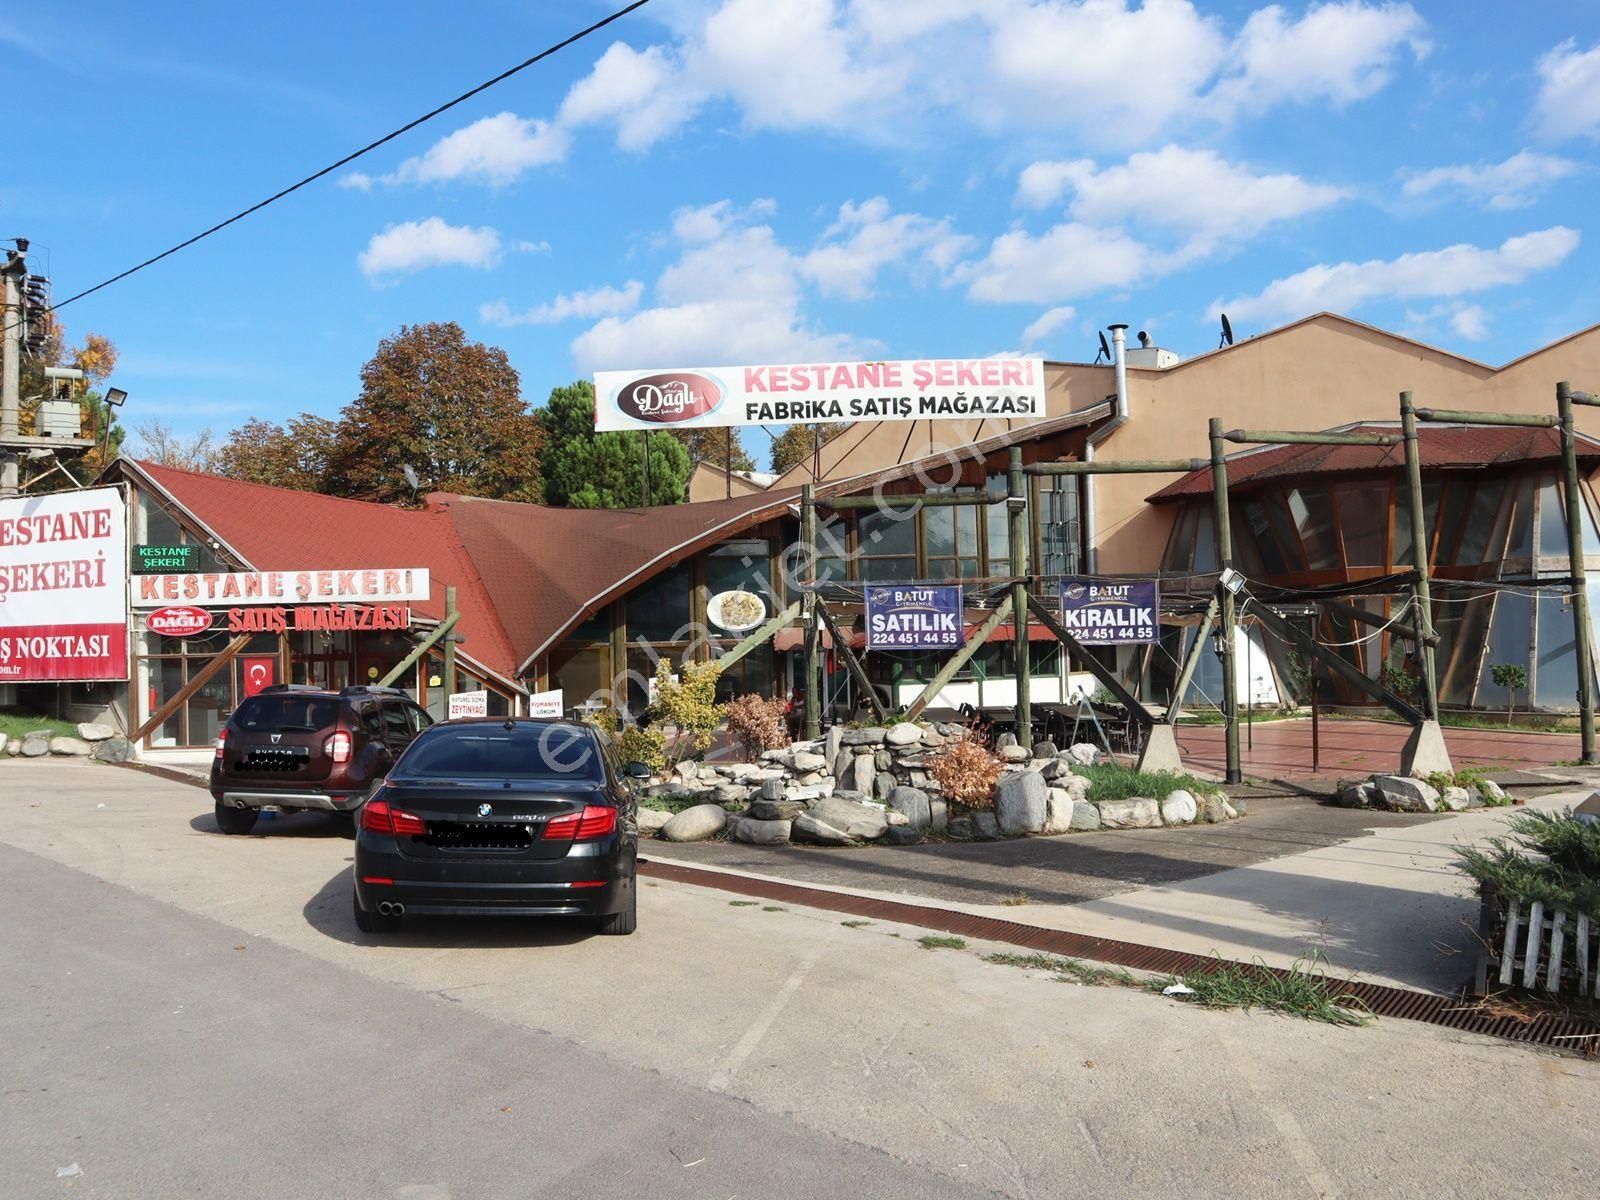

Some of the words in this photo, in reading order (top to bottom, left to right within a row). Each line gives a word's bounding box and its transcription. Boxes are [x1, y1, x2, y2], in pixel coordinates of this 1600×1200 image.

[744, 363, 902, 392] KESTANE
[850, 397, 912, 418] SATIŞ
[919, 391, 1036, 414] MAĞAZASI
[139, 547, 191, 557] KESTANE
[143, 557, 186, 568] ŞEKERİ
[141, 572, 284, 599] KESTANE
[1089, 585, 1130, 596] BATUT
[895, 590, 934, 601] BATUT
[228, 606, 287, 634] SATIŞ
[295, 602, 407, 630] MAĞAZASI
[872, 613, 957, 632] SATILIK
[872, 633, 895, 644] 224
[898, 633, 919, 644] 451
[923, 632, 939, 643] 44
[942, 632, 957, 643] 55
[1092, 628, 1114, 639] 451
[1118, 627, 1134, 638] 44
[1137, 626, 1154, 638] 55
[16, 634, 110, 659] NOKTASI
